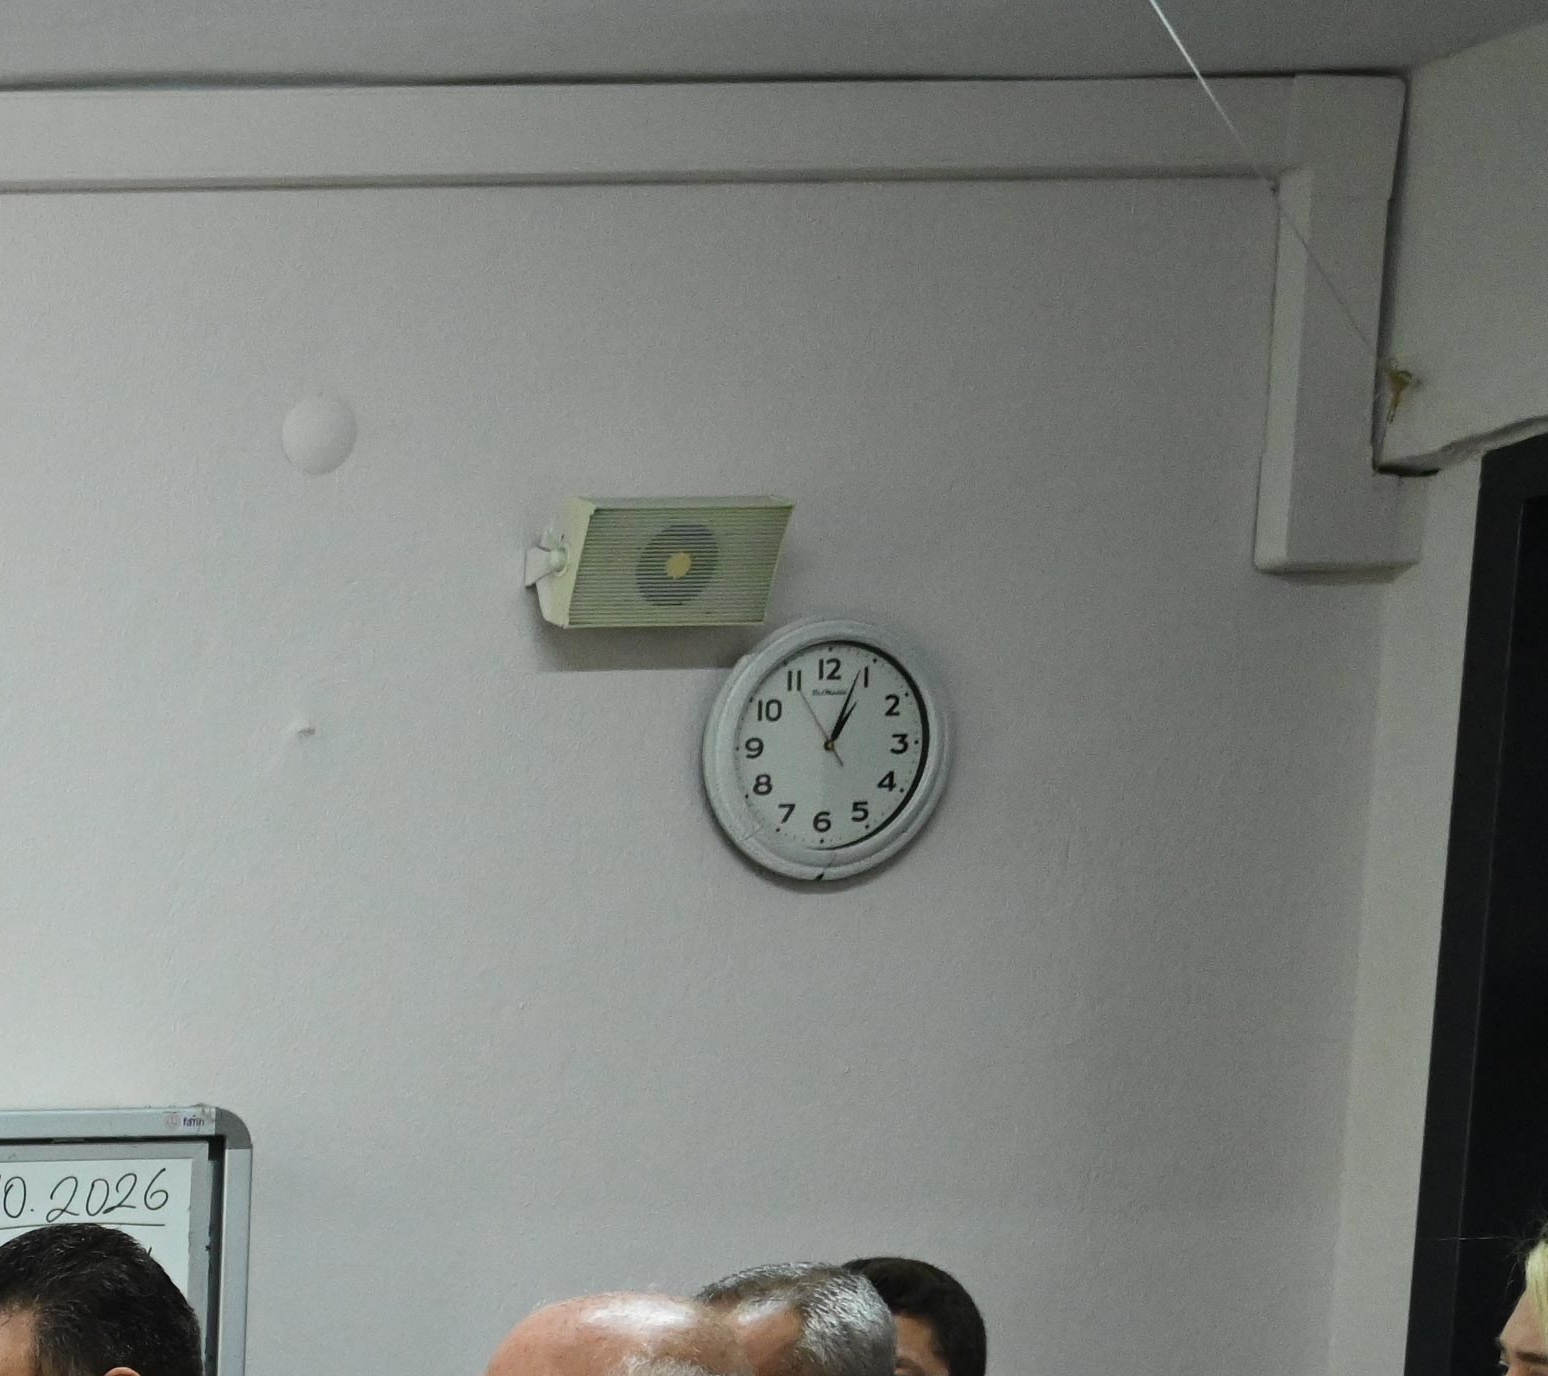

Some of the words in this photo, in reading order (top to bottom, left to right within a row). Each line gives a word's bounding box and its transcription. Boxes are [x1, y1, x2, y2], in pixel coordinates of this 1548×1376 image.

[818, 658, 842, 681] 12
[864, 666, 869, 688] 1
[787, 670, 802, 692] 11
[757, 699, 783, 722] 10
[885, 694, 901, 717] 2
[745, 737, 764, 760] 9
[891, 734, 909, 755] 3
[752, 774, 773, 796] 8
[877, 771, 897, 792] 4
[778, 803, 796, 824] 7
[813, 811, 832, 832] 6
[851, 801, 869, 822] 5
